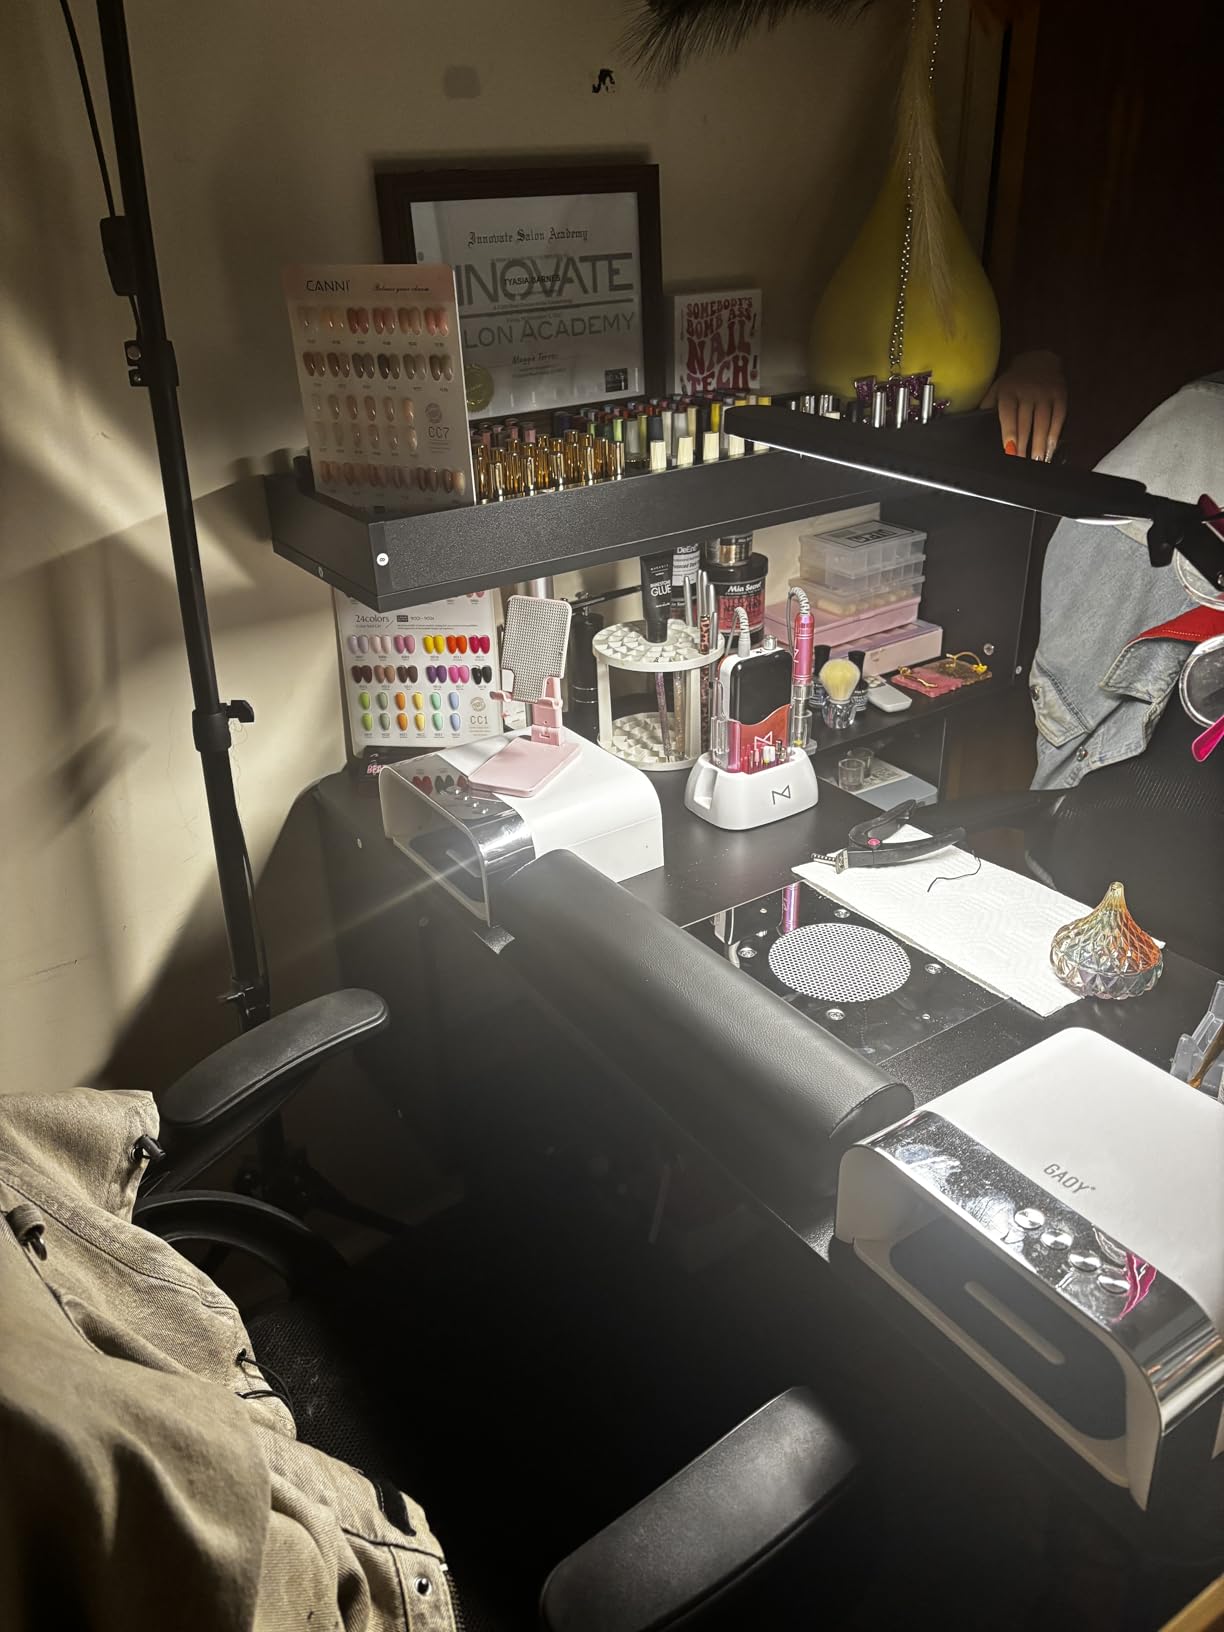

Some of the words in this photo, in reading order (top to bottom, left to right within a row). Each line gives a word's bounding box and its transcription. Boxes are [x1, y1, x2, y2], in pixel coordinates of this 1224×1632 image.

[467, 231, 513, 248] Innovate
[516, 228, 545, 242] Salon
[548, 226, 589, 242] Academy
[305, 279, 350, 292] CANNI
[531, 274, 561, 284] BARNES
[686, 297, 753, 320] SOMEBODY'S
[728, 307, 752, 322] ASS
[520, 312, 635, 342] ACADEMY
[686, 320, 751, 375] NAIL
[428, 426, 450, 439] CC7
[650, 583, 672, 597] GLUE
[727, 585, 744, 593] Mia
[355, 614, 390, 624] 24colors
[470, 715, 489, 725] CC1
